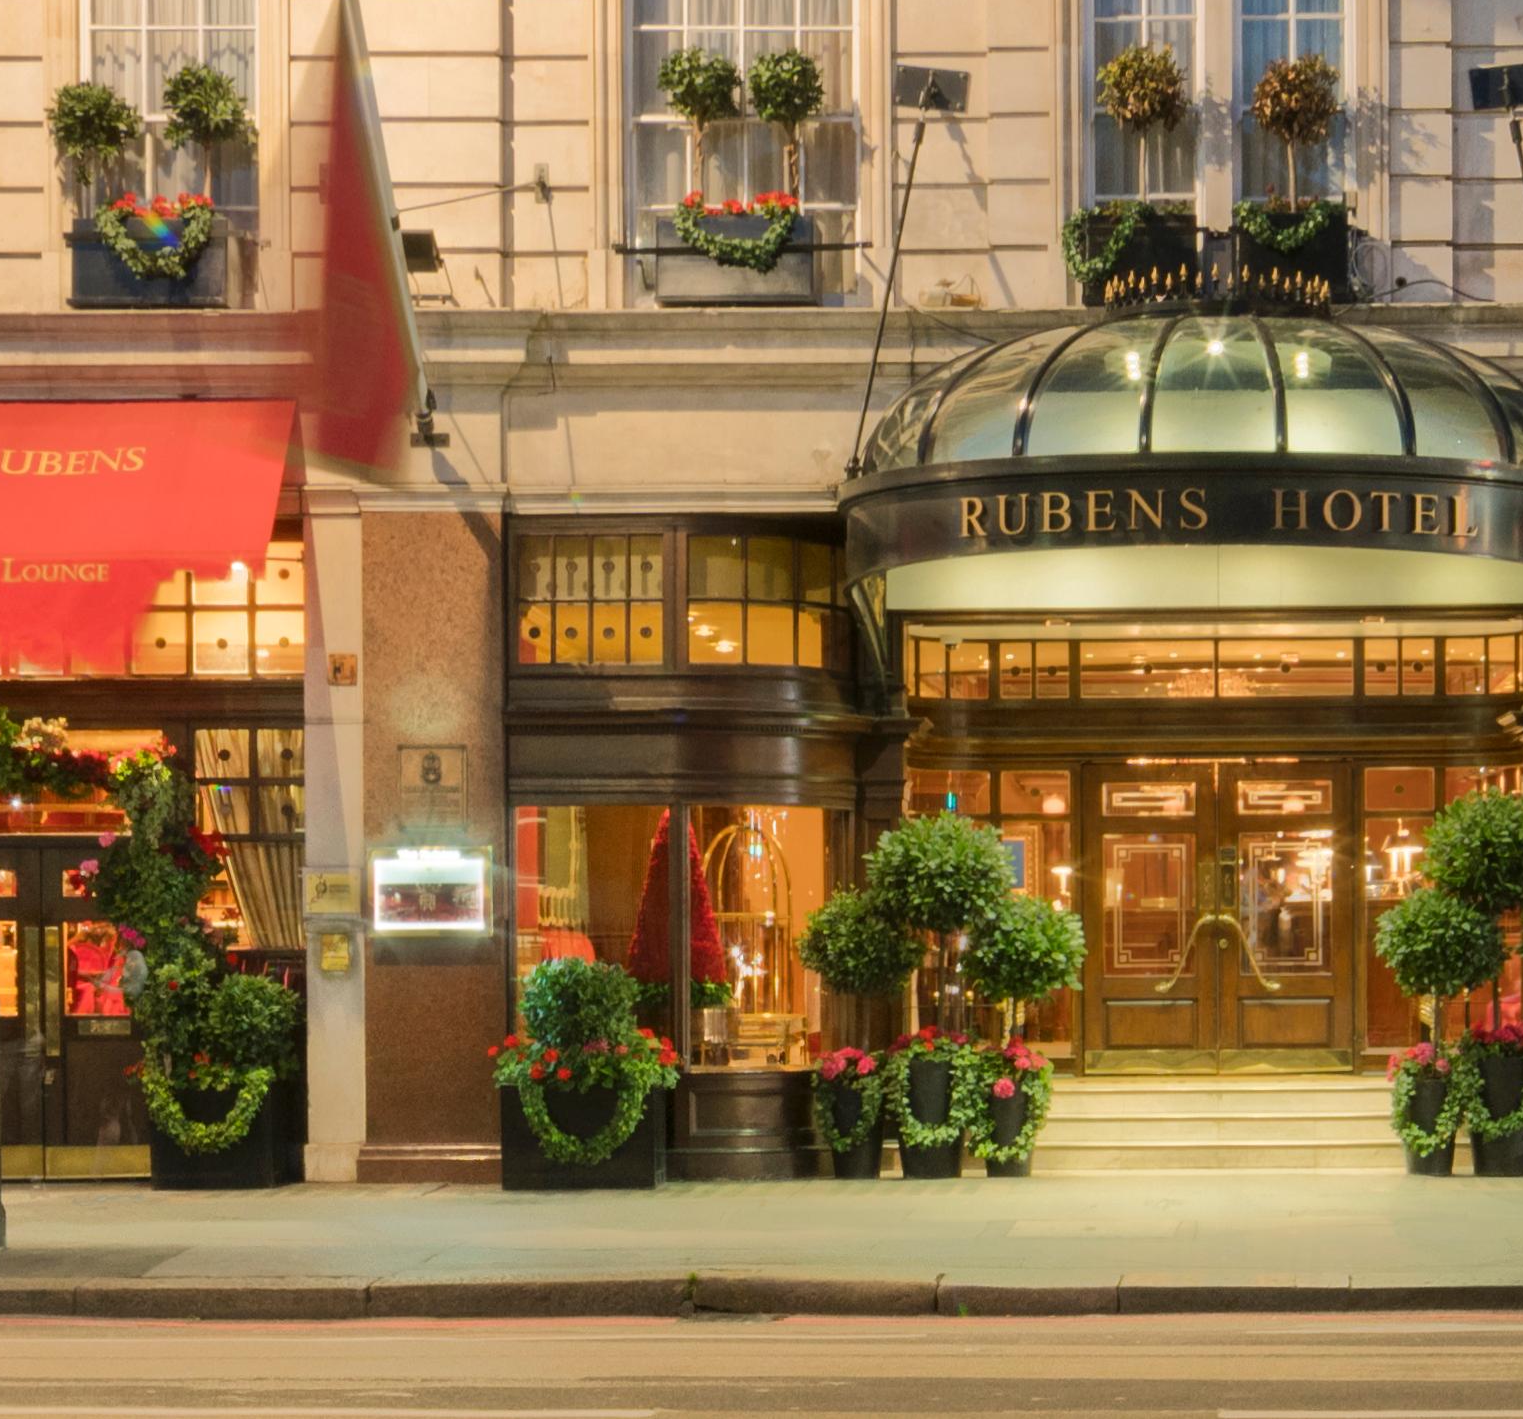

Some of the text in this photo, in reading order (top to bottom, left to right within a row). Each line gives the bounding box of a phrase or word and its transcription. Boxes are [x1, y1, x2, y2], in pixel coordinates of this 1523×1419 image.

[958, 487, 1480, 539] RUBENS HOTEL
[1, 557, 110, 583] LOUNGE
